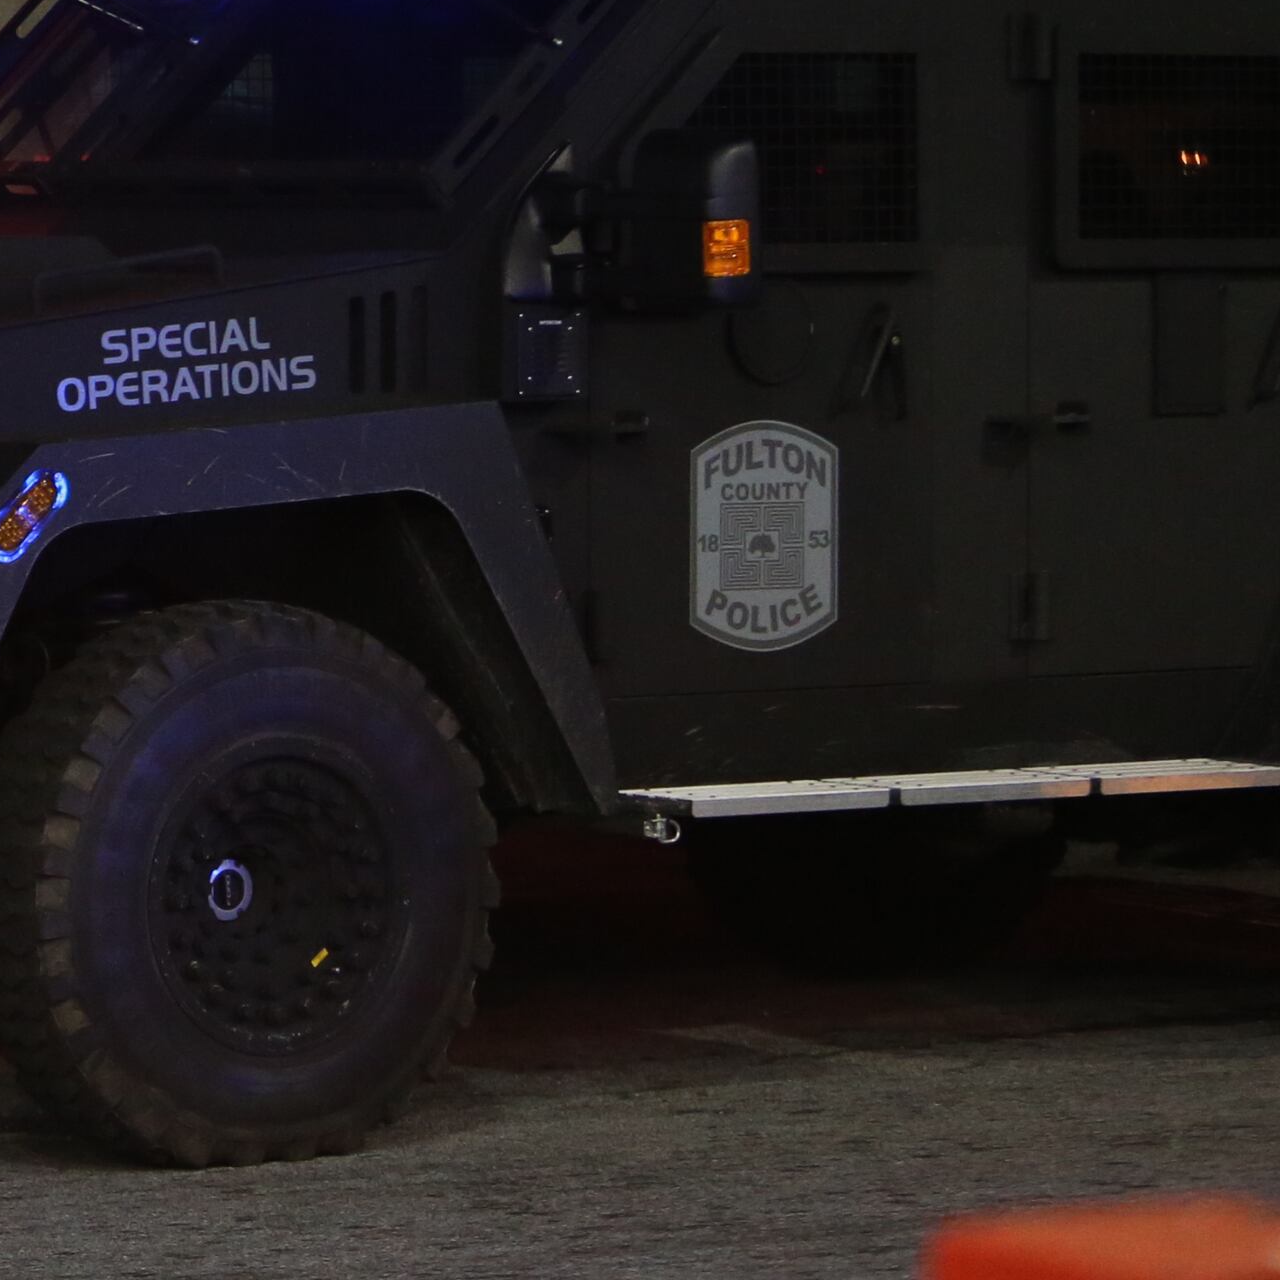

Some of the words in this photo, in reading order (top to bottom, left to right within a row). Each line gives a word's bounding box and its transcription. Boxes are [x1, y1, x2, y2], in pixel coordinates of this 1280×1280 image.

[101, 316, 271, 365] SPECIAL
[56, 355, 317, 412] OPERATIONS
[704, 439, 826, 489] FULTON
[721, 482, 808, 501] COUNTY
[698, 534, 719, 552] 18
[808, 531, 829, 548] 53
[705, 584, 822, 633] POLICE
